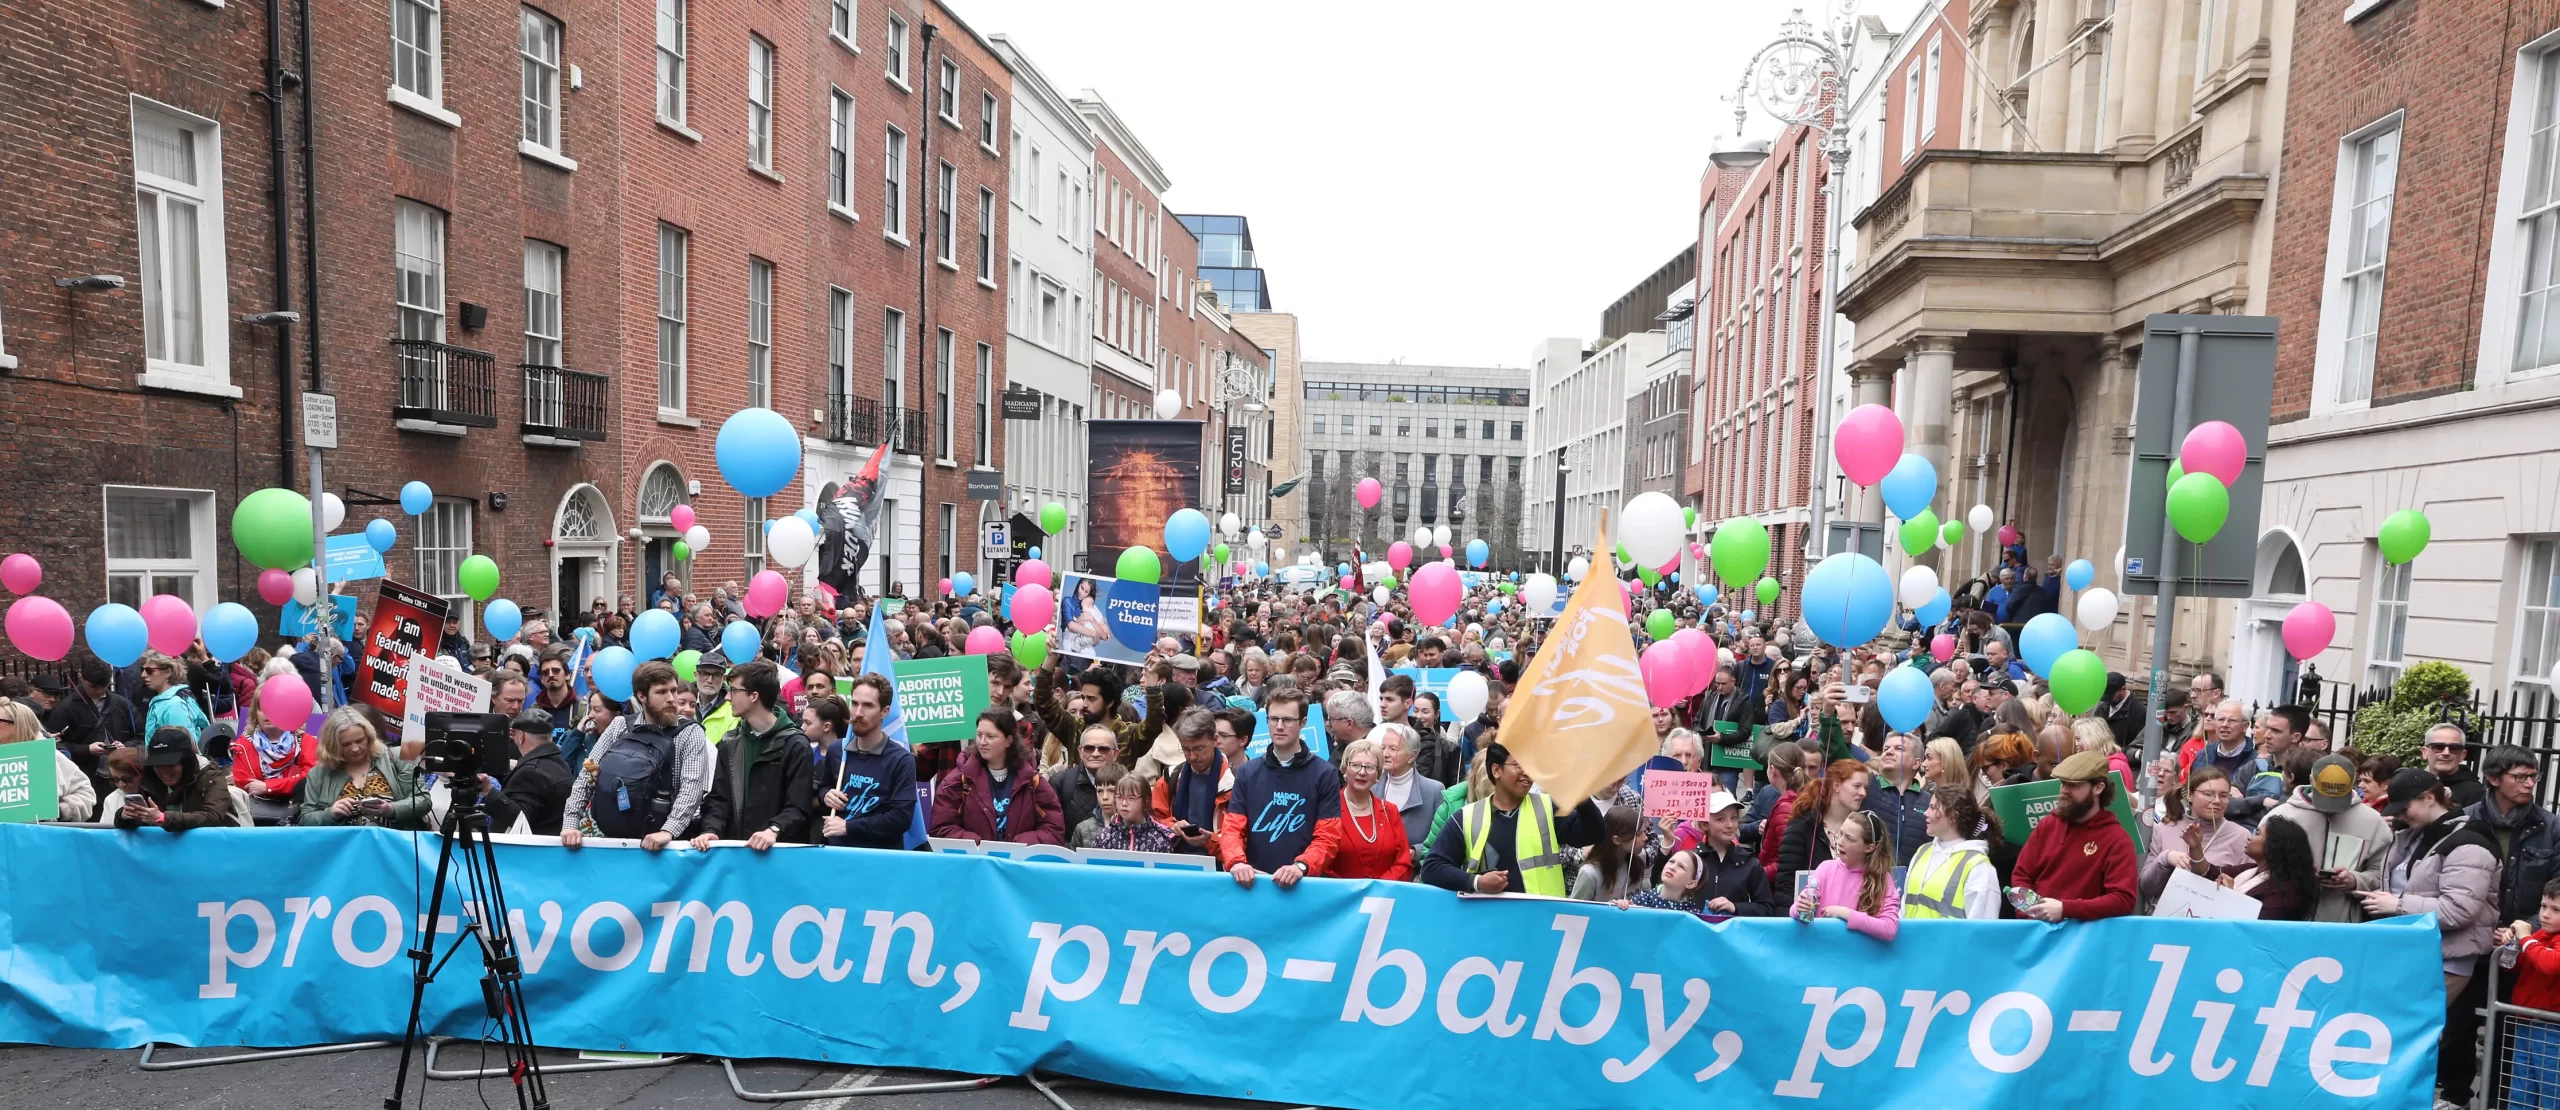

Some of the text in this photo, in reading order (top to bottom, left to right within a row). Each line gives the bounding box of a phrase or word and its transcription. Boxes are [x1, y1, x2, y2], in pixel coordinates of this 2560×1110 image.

[1230, 434, 1243, 486] kazumi
[994, 533, 1003, 544] P
[1012, 540, 1027, 549] Let
[1108, 598, 1157, 612] protect
[1118, 609, 1153, 626] them
[403, 622, 420, 637] am
[366, 655, 409, 681] wonderf
[420, 664, 478, 693] At just 10 weeks
[898, 676, 962, 693] ABORTION
[420, 674, 476, 702] an unborn baby
[420, 684, 434, 695] has
[436, 689, 443, 698] 10
[417, 691, 424, 700] 10
[445, 703, 450, 711] a
[900, 690, 963, 706] BETRAYS
[902, 704, 965, 722] WOMEN
[849, 780, 862, 788] FOR
[850, 773, 874, 784] MARCH
[1273, 791, 1300, 800] MARCH
[1273, 798, 1288, 807] FOR
[1694, 798, 1706, 807] IS
[1666, 799, 1680, 808] LIE
[1651, 806, 1706, 818] PRO-COICE
[199, 895, 2392, 1099] pro-woman, pro-baby, pro-life
